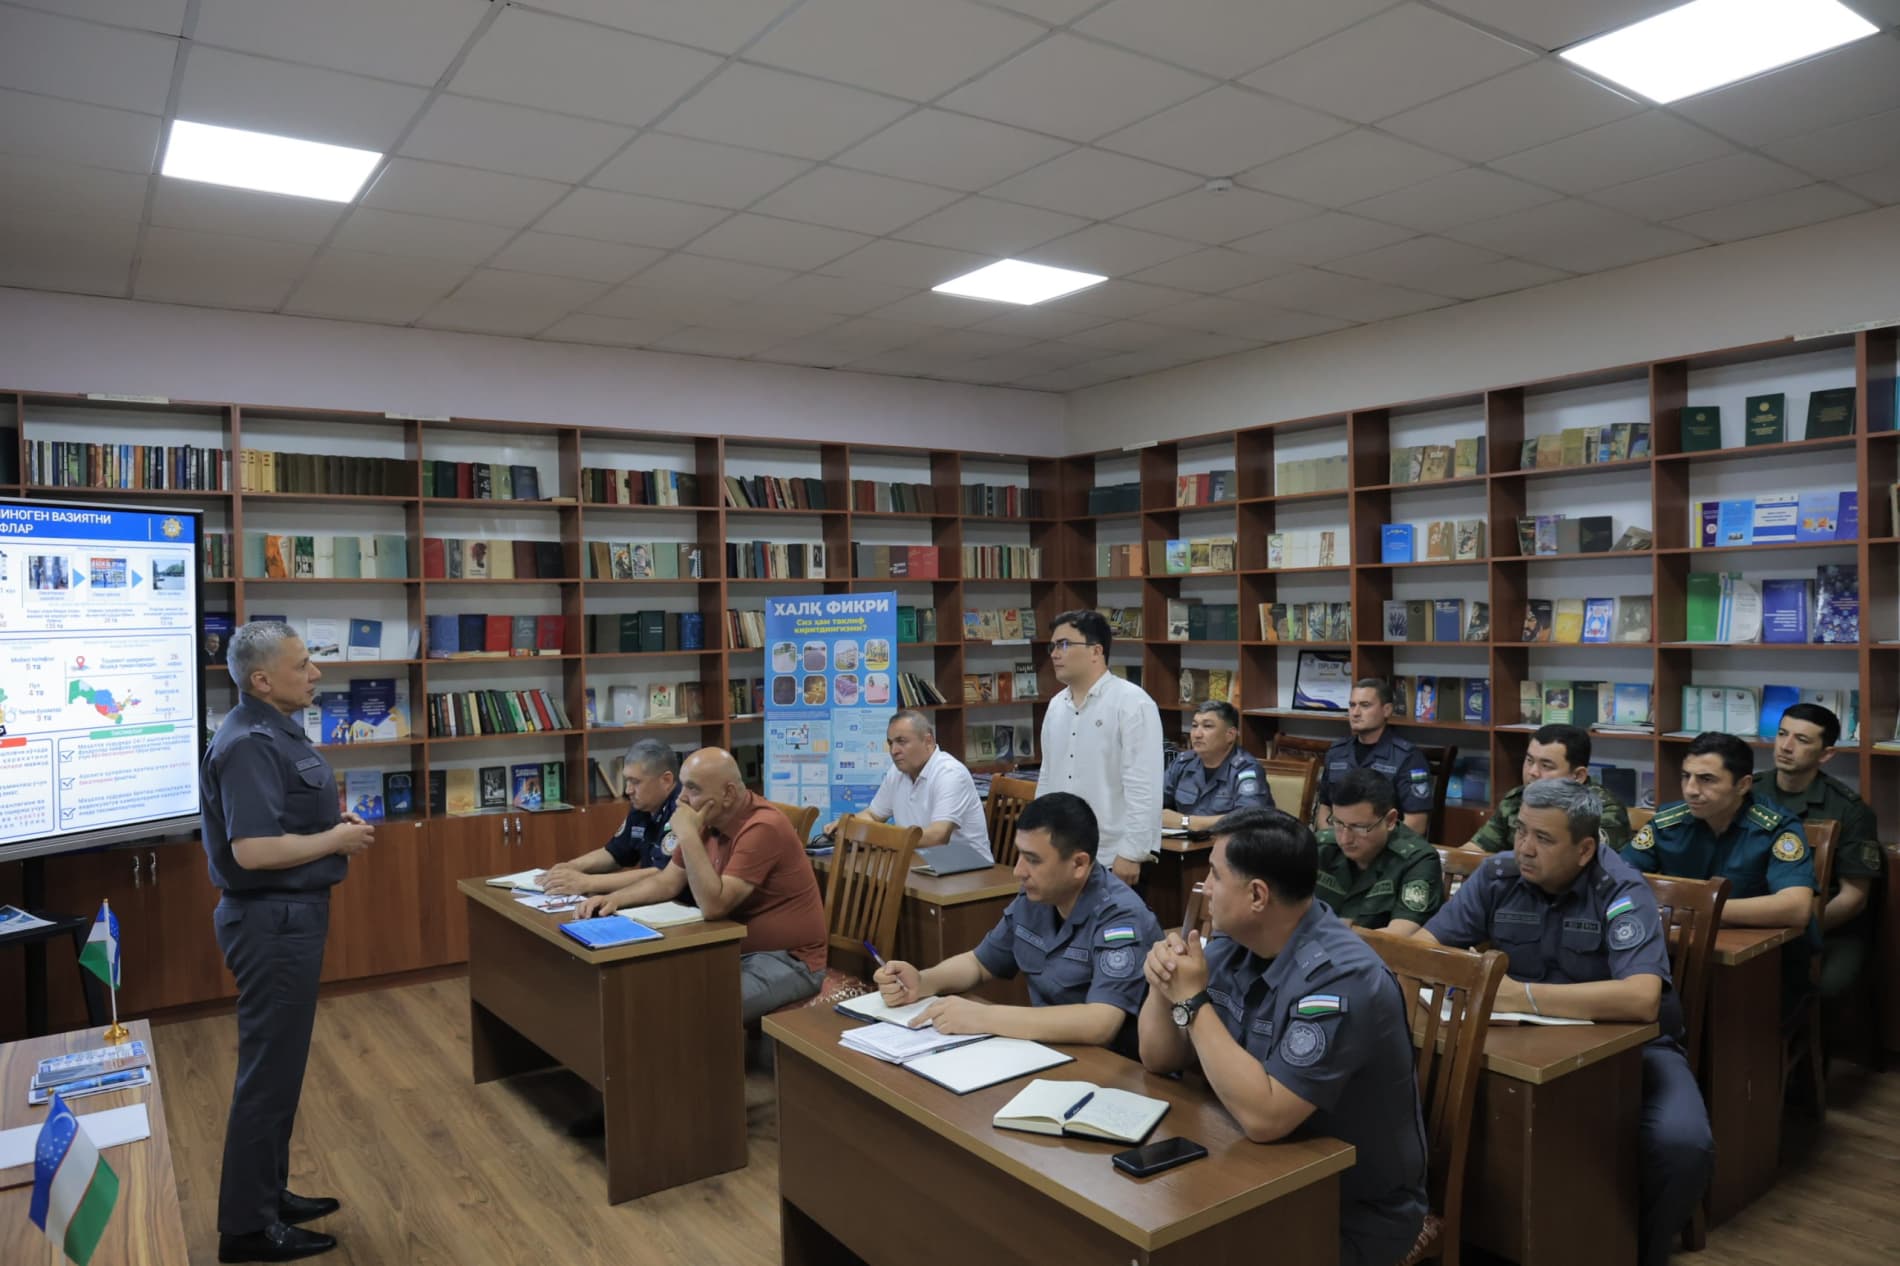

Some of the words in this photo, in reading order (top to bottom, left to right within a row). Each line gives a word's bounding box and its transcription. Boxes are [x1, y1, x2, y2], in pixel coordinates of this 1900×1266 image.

[52, 511, 112, 524] ВАЗИЯТНИ
[774, 601, 822, 617] ХАЛҚ
[826, 599, 889, 614] ФИКРИ
